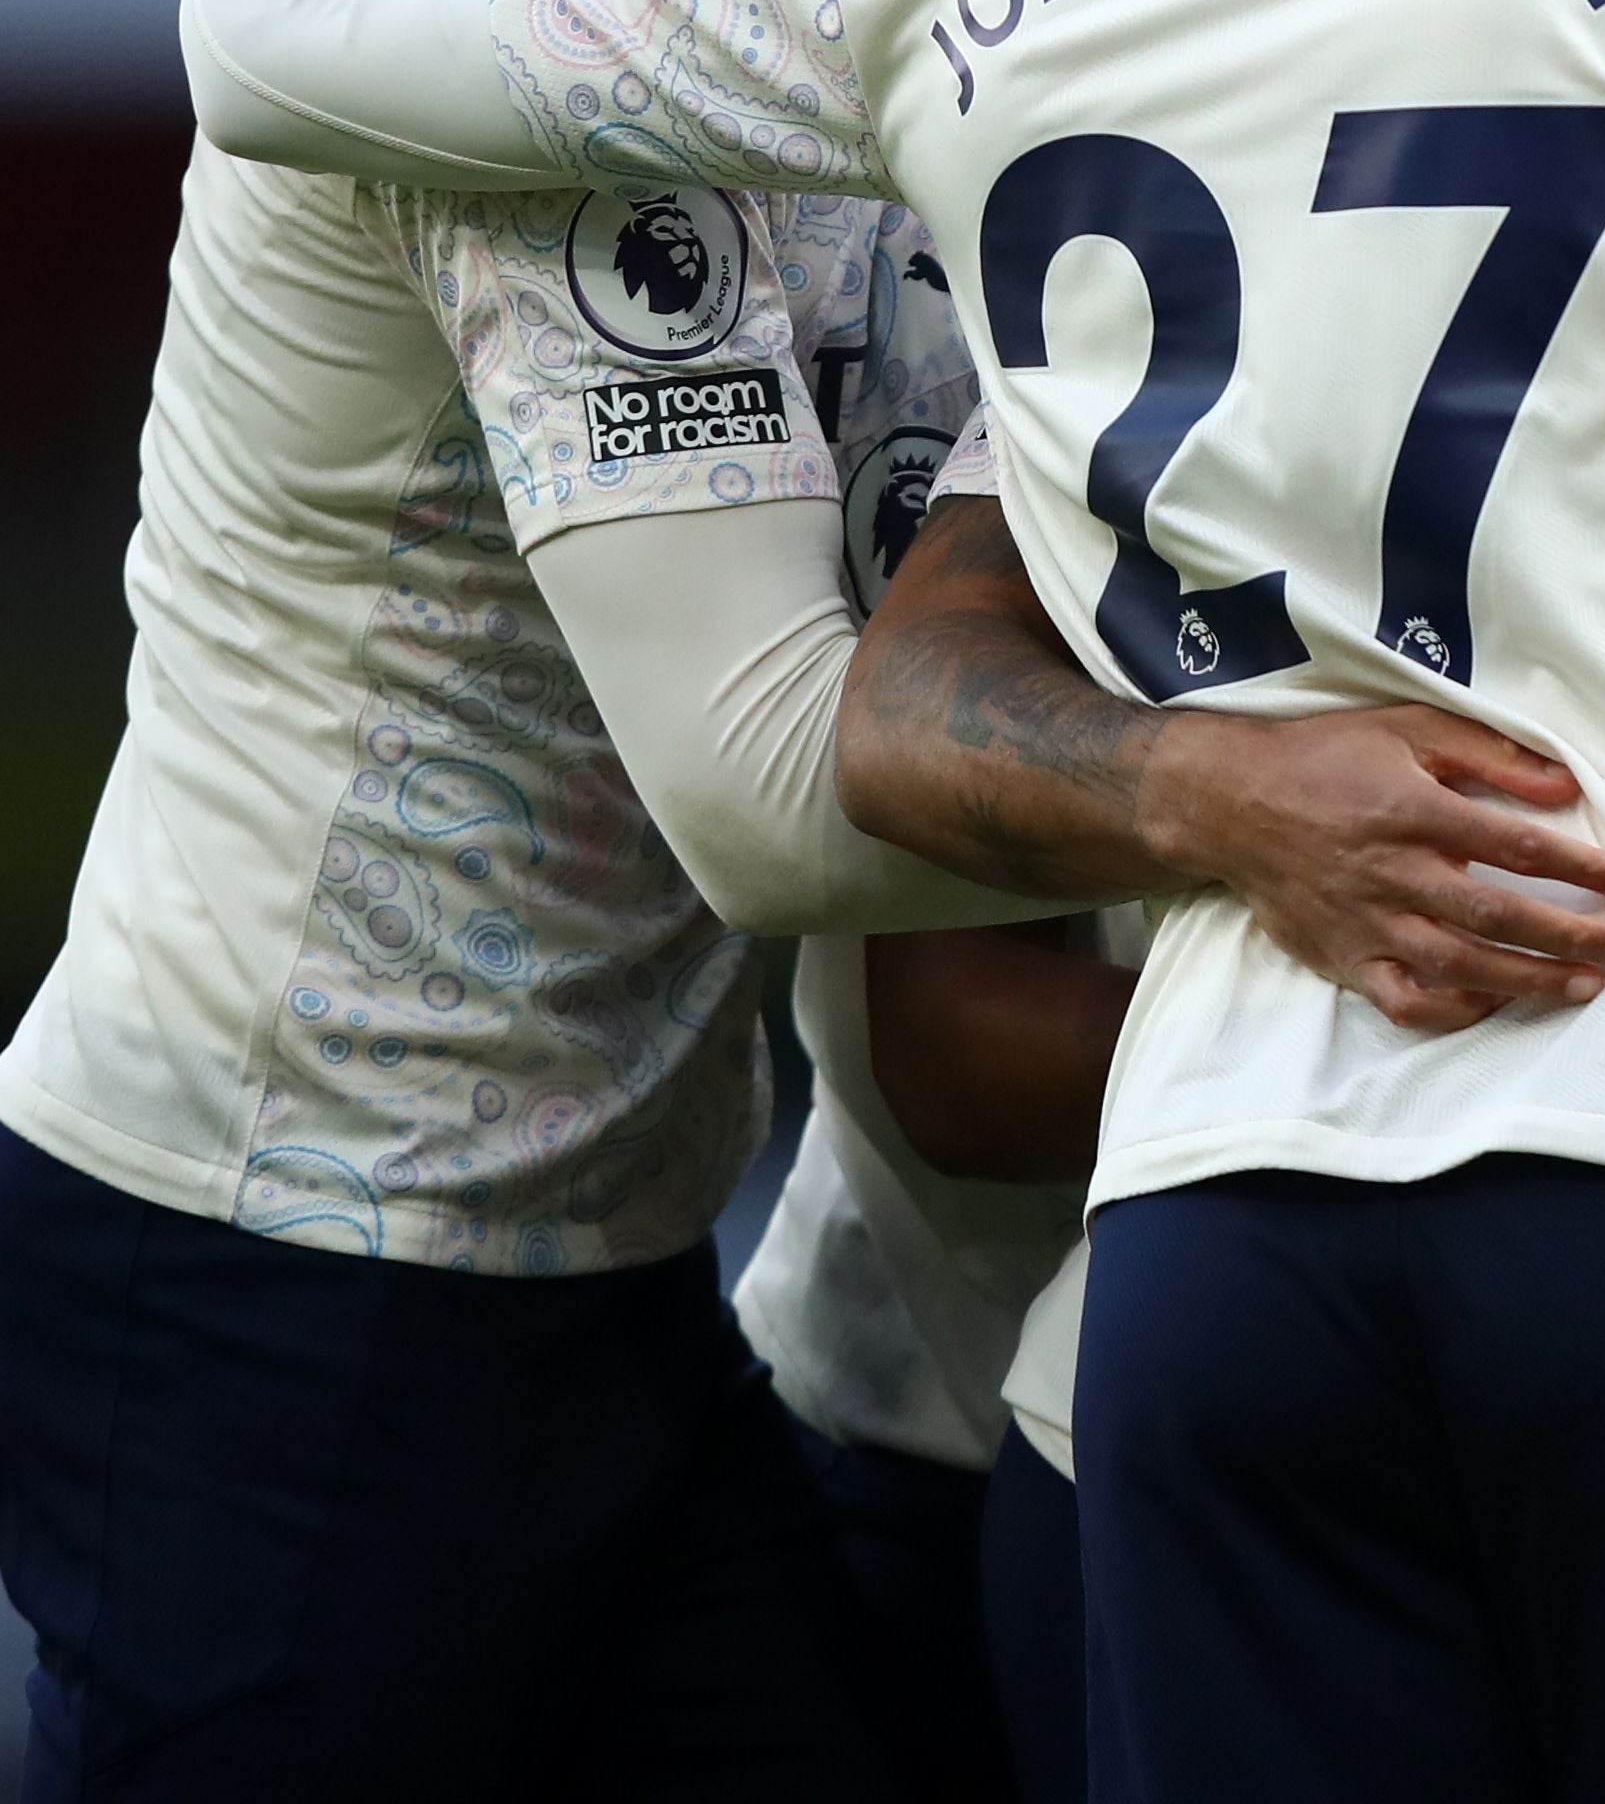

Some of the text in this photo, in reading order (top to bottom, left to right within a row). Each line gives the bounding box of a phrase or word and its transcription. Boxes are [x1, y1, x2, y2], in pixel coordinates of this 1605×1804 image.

[667, 254, 732, 341] Premier League
[585, 380, 767, 427] No room
[591, 413, 789, 461] for racism
